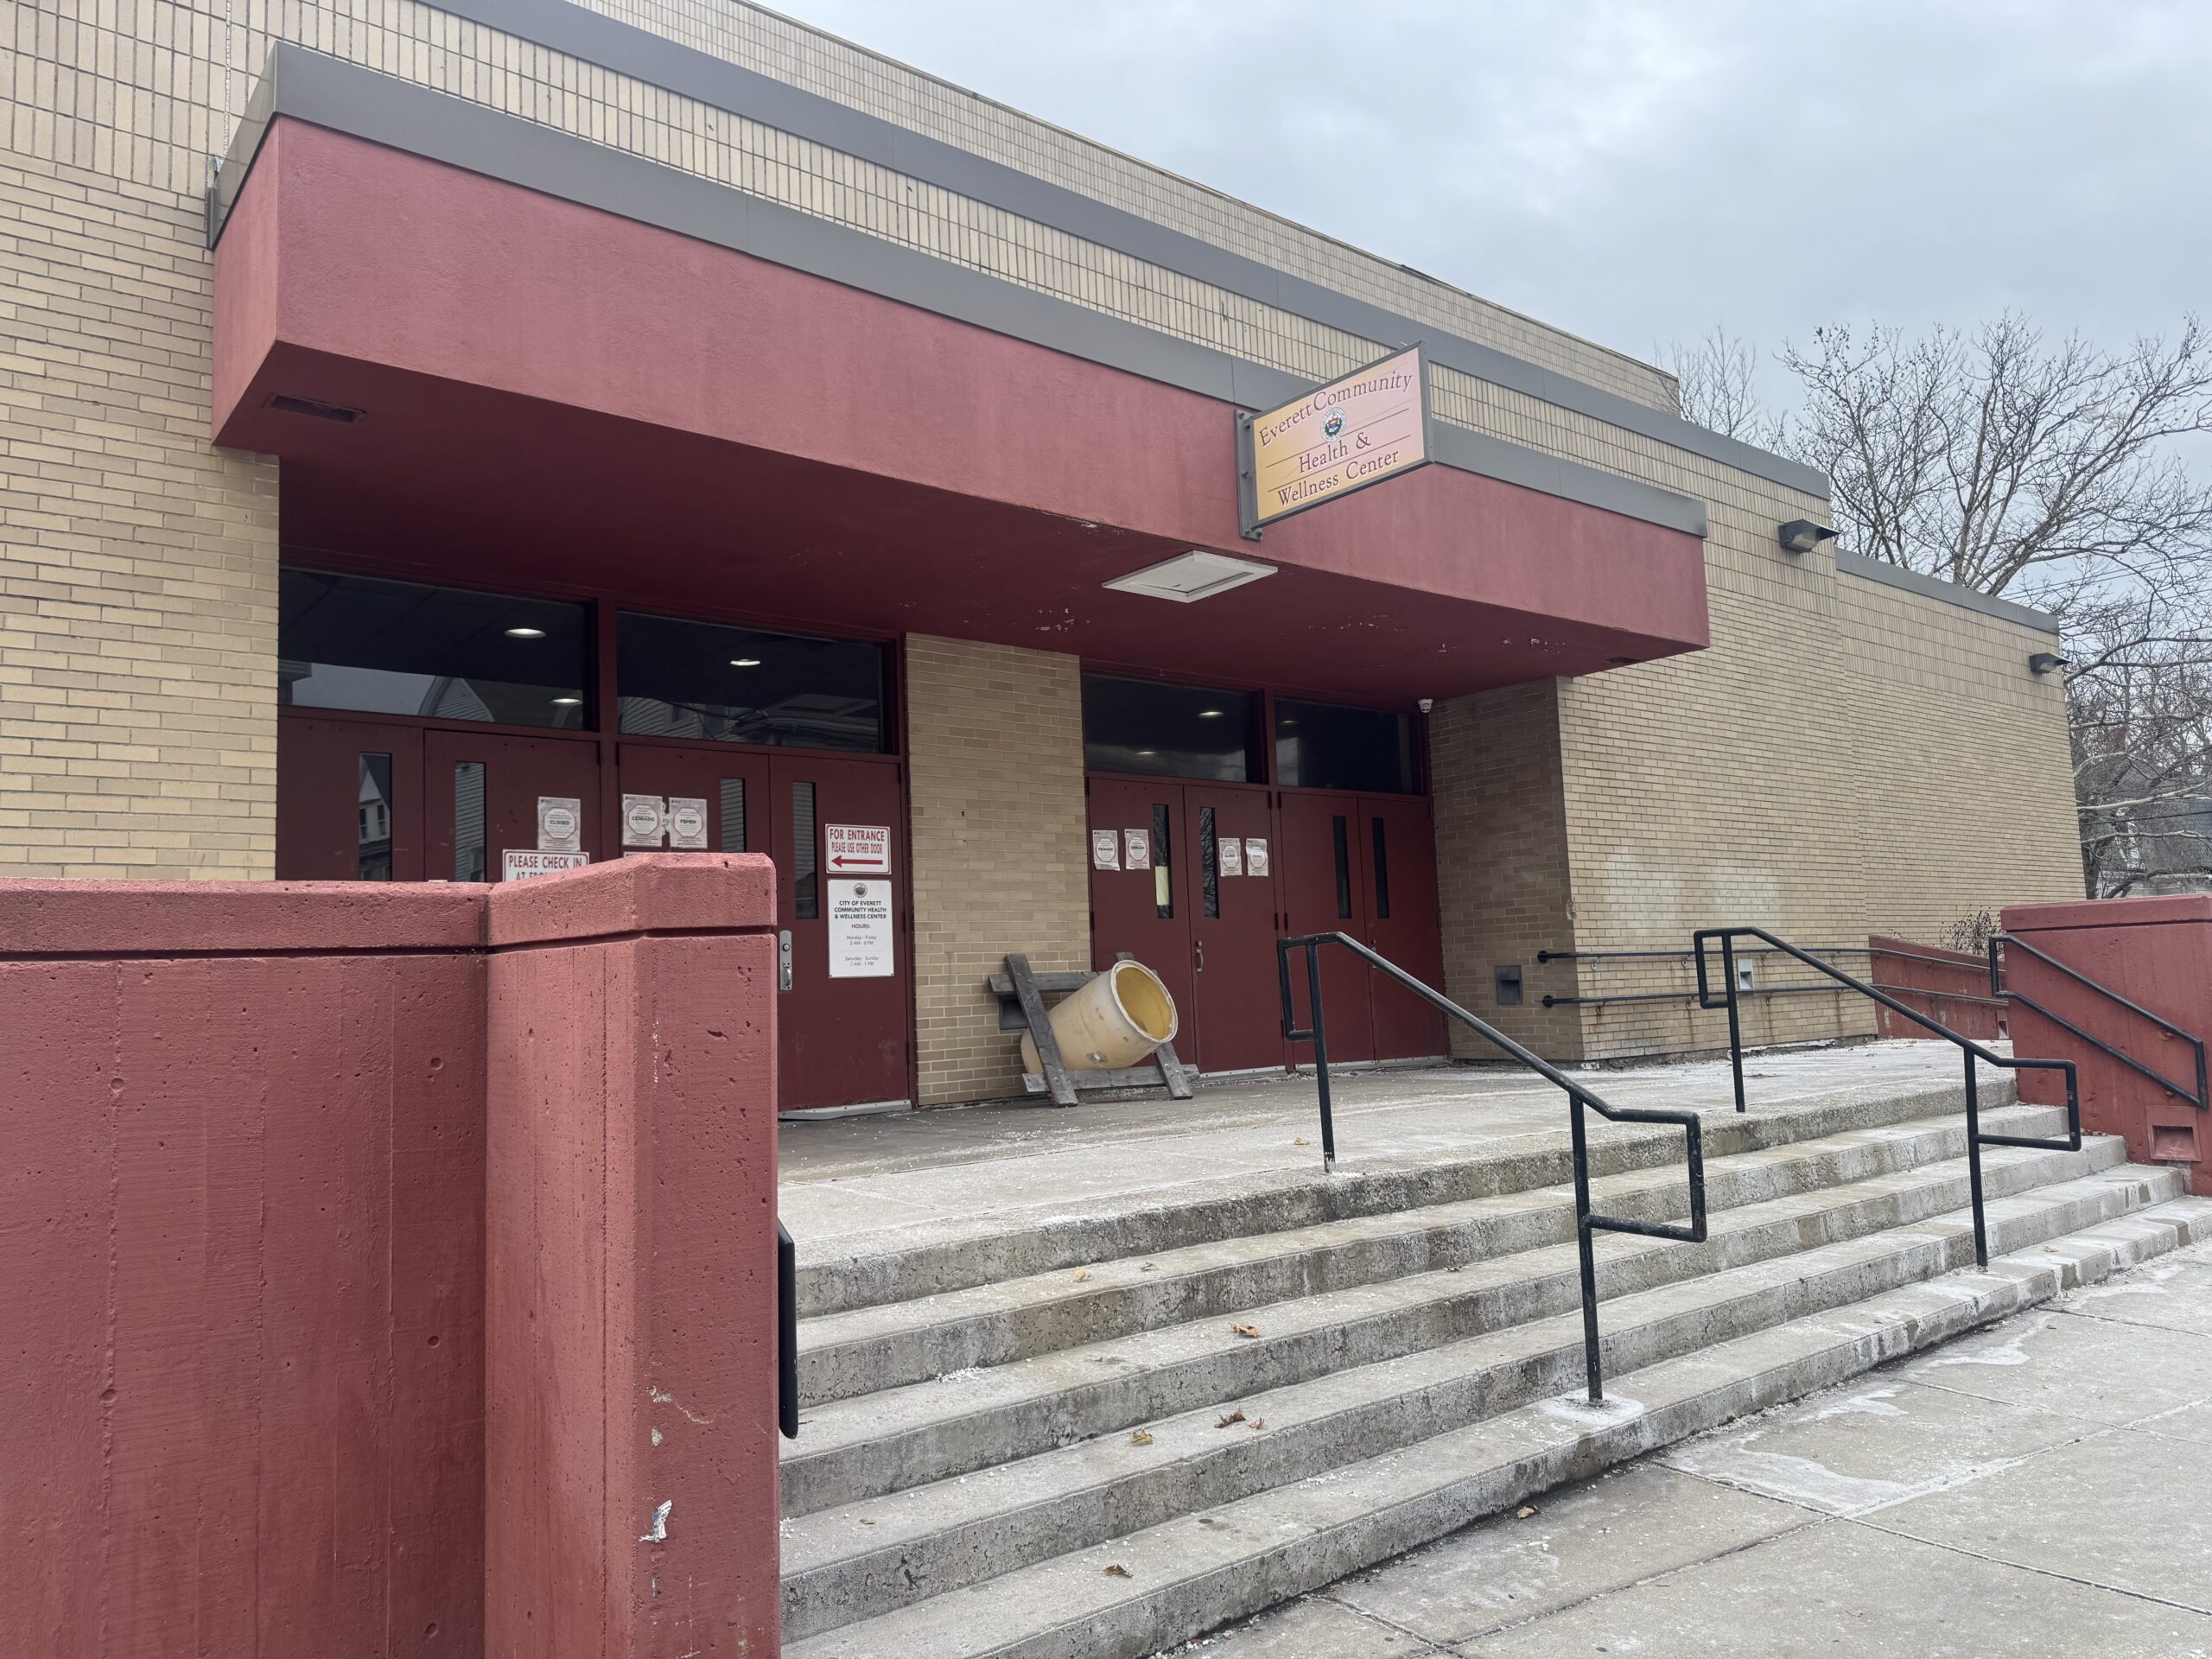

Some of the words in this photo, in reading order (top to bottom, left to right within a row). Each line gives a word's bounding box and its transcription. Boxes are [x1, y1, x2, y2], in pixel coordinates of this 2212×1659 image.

[1259, 403, 1313, 447] Everett
[1313, 371, 1413, 410] Community
[1299, 440, 1349, 474] Health
[1355, 431, 1372, 449] &
[1277, 474, 1339, 506] Wellness
[1345, 449, 1399, 480] Center
[830, 829, 844, 840] FOR
[848, 830, 885, 842] ENTRANCE
[831, 842, 846, 853] PLEASE
[856, 842, 869, 854] OTHER
[871, 843, 883, 855] DOOR
[508, 855, 538, 868] PLEASE
[543, 856, 569, 869] CHECK
[573, 857, 582, 869] IN
